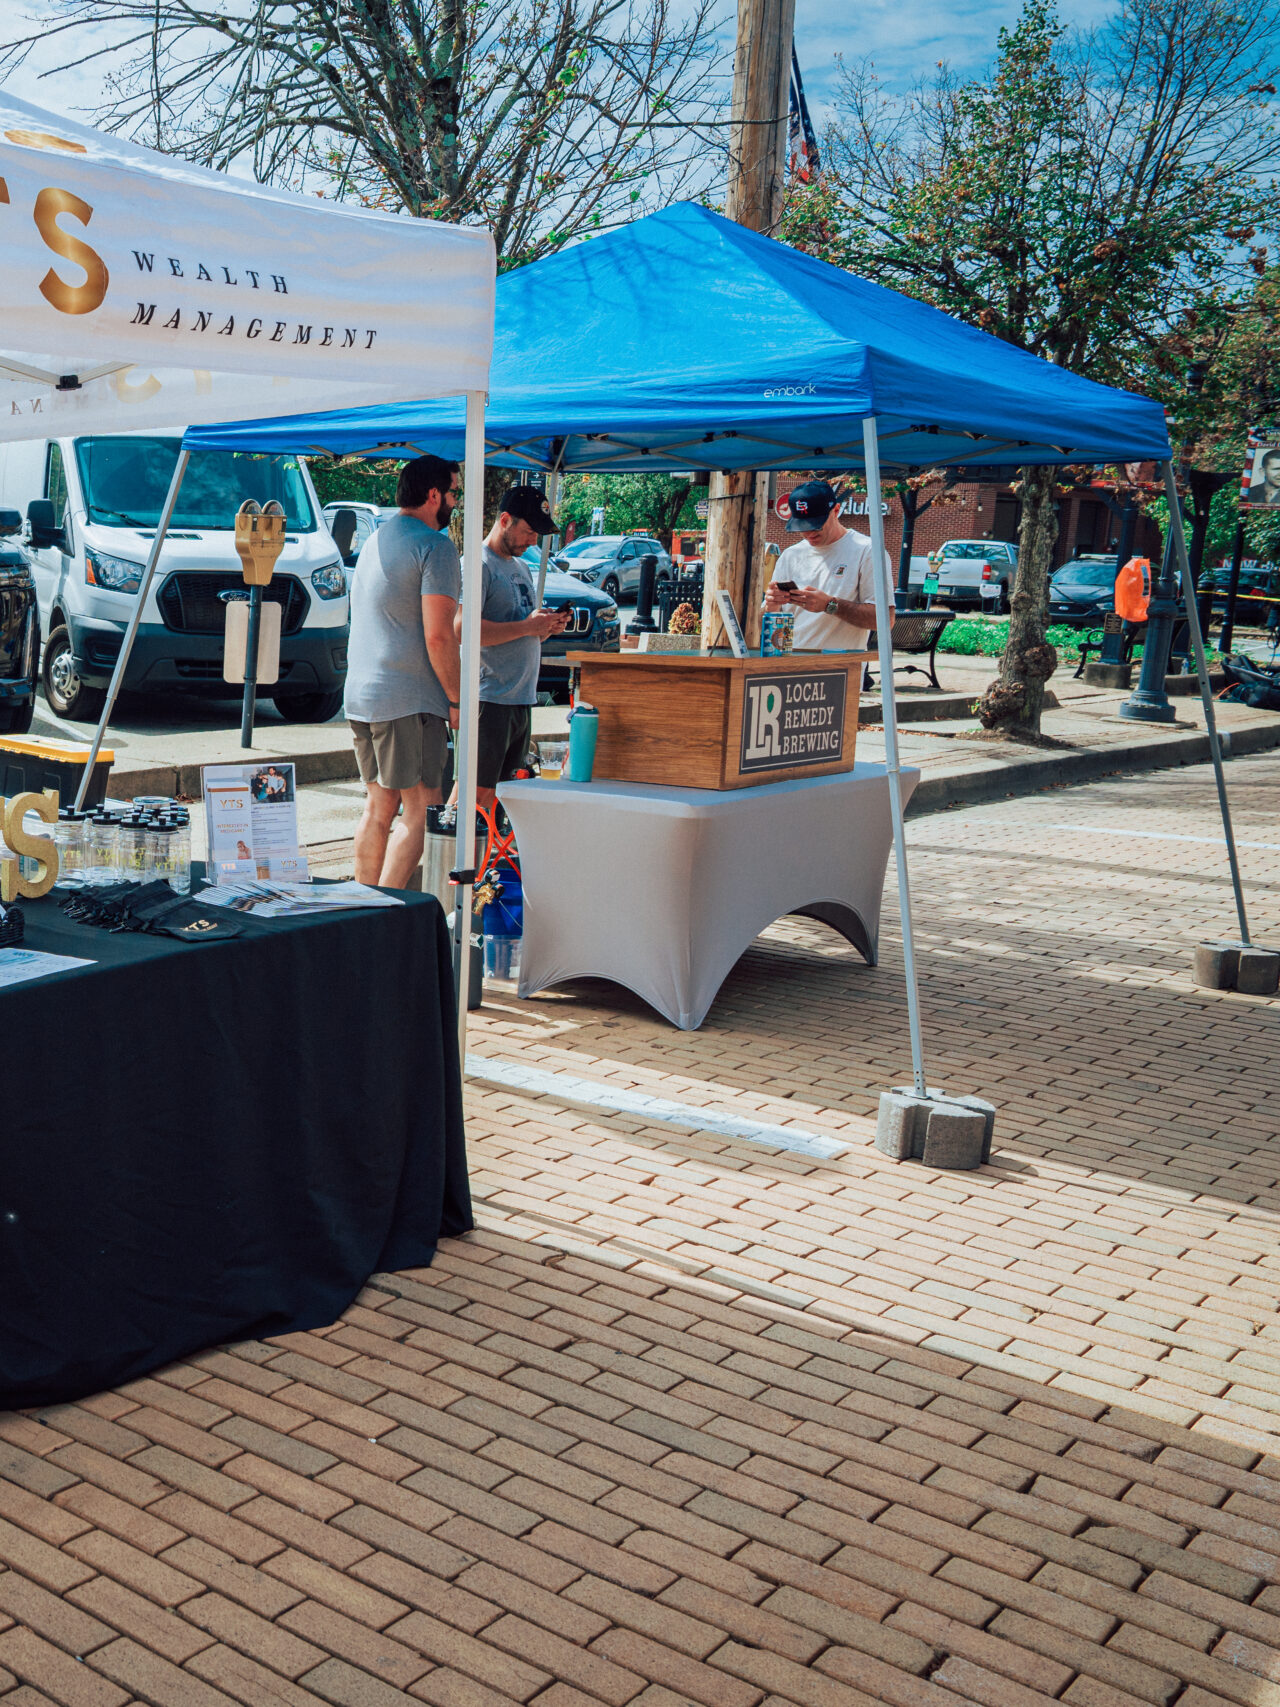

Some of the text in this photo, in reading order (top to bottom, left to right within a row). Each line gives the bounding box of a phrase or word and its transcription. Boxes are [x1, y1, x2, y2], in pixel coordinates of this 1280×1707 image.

[131, 250, 289, 294] WEALTH
[130, 302, 378, 349] MANAGEMENT
[763, 383, 817, 398] embark
[1223, 559, 1257, 568] NW
[785, 682, 827, 704] LOCAL
[784, 706, 835, 730] REMEDY
[782, 730, 839, 756] BREWING
[220, 799, 243, 808] YTS
[62, 850, 81, 859] YTS
[281, 860, 297, 869] YTS
